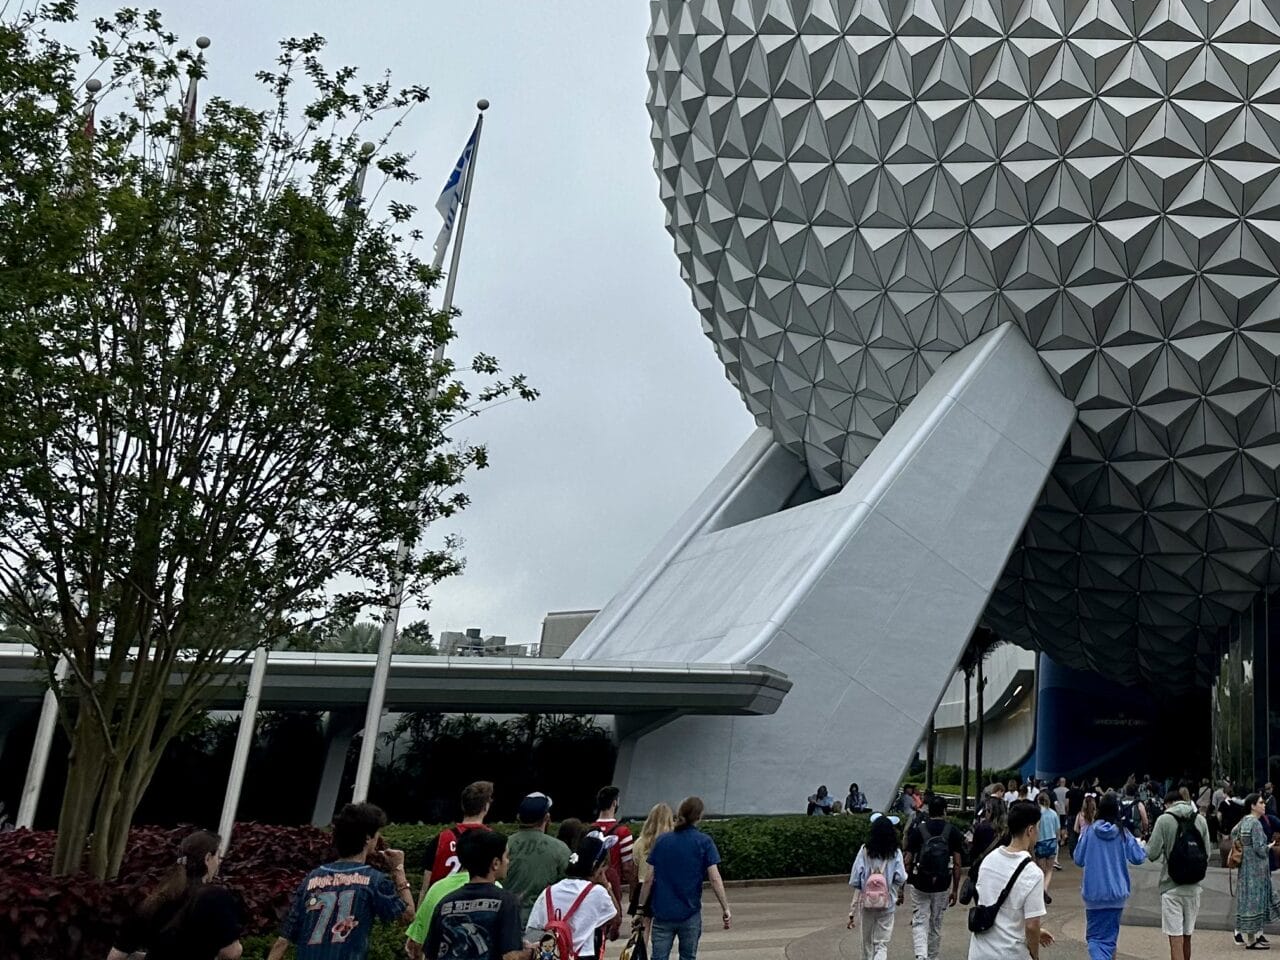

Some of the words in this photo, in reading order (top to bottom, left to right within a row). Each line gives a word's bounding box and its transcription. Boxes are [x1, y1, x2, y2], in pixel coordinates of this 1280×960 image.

[307, 876, 333, 891] Magic
[332, 872, 371, 886] Kingdom
[454, 900, 501, 913] SHELBY
[306, 889, 357, 945] 71
